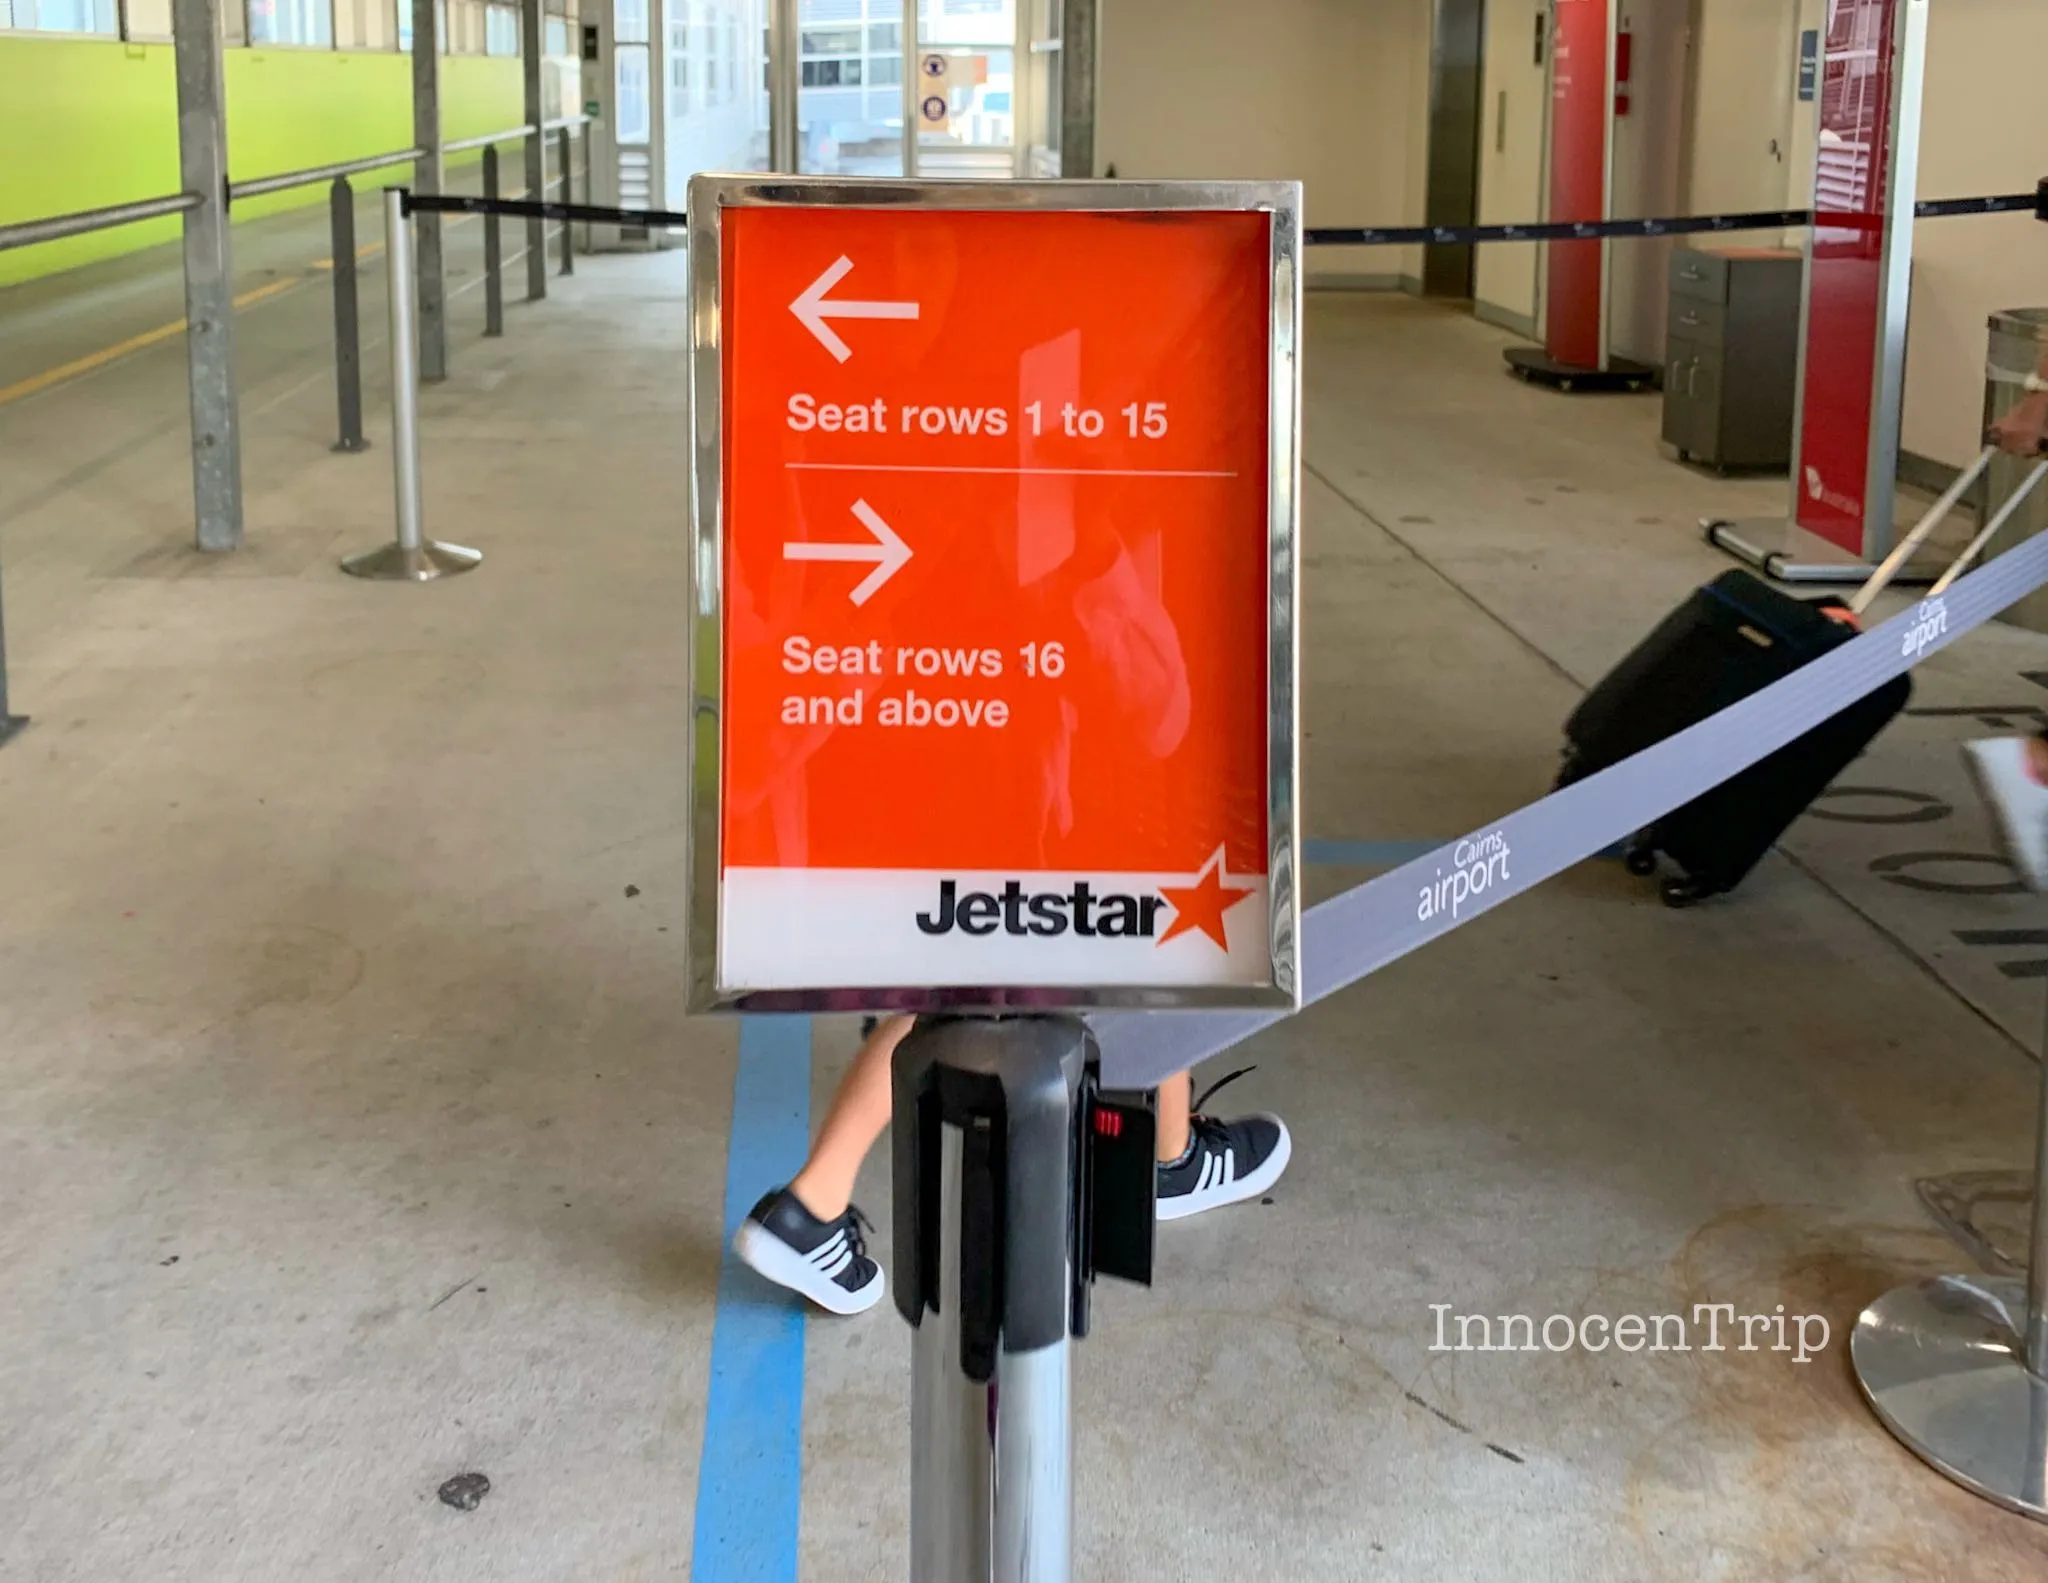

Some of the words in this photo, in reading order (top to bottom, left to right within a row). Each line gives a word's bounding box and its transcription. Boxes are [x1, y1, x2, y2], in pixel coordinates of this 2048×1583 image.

[787, 393, 887, 433] Seat
[901, 403, 1008, 436] rows
[1025, 401, 1042, 436] 1
[1061, 402, 1104, 438] to
[1121, 402, 1168, 439] 15
[782, 636, 882, 674] Seat
[896, 646, 1003, 677] rows
[1019, 641, 1066, 678] 16
[781, 688, 863, 725] and
[878, 690, 1009, 727] above
[1454, 830, 1503, 869] Cairns
[1417, 841, 1510, 922] airport
[915, 879, 1169, 937] Jetstar
